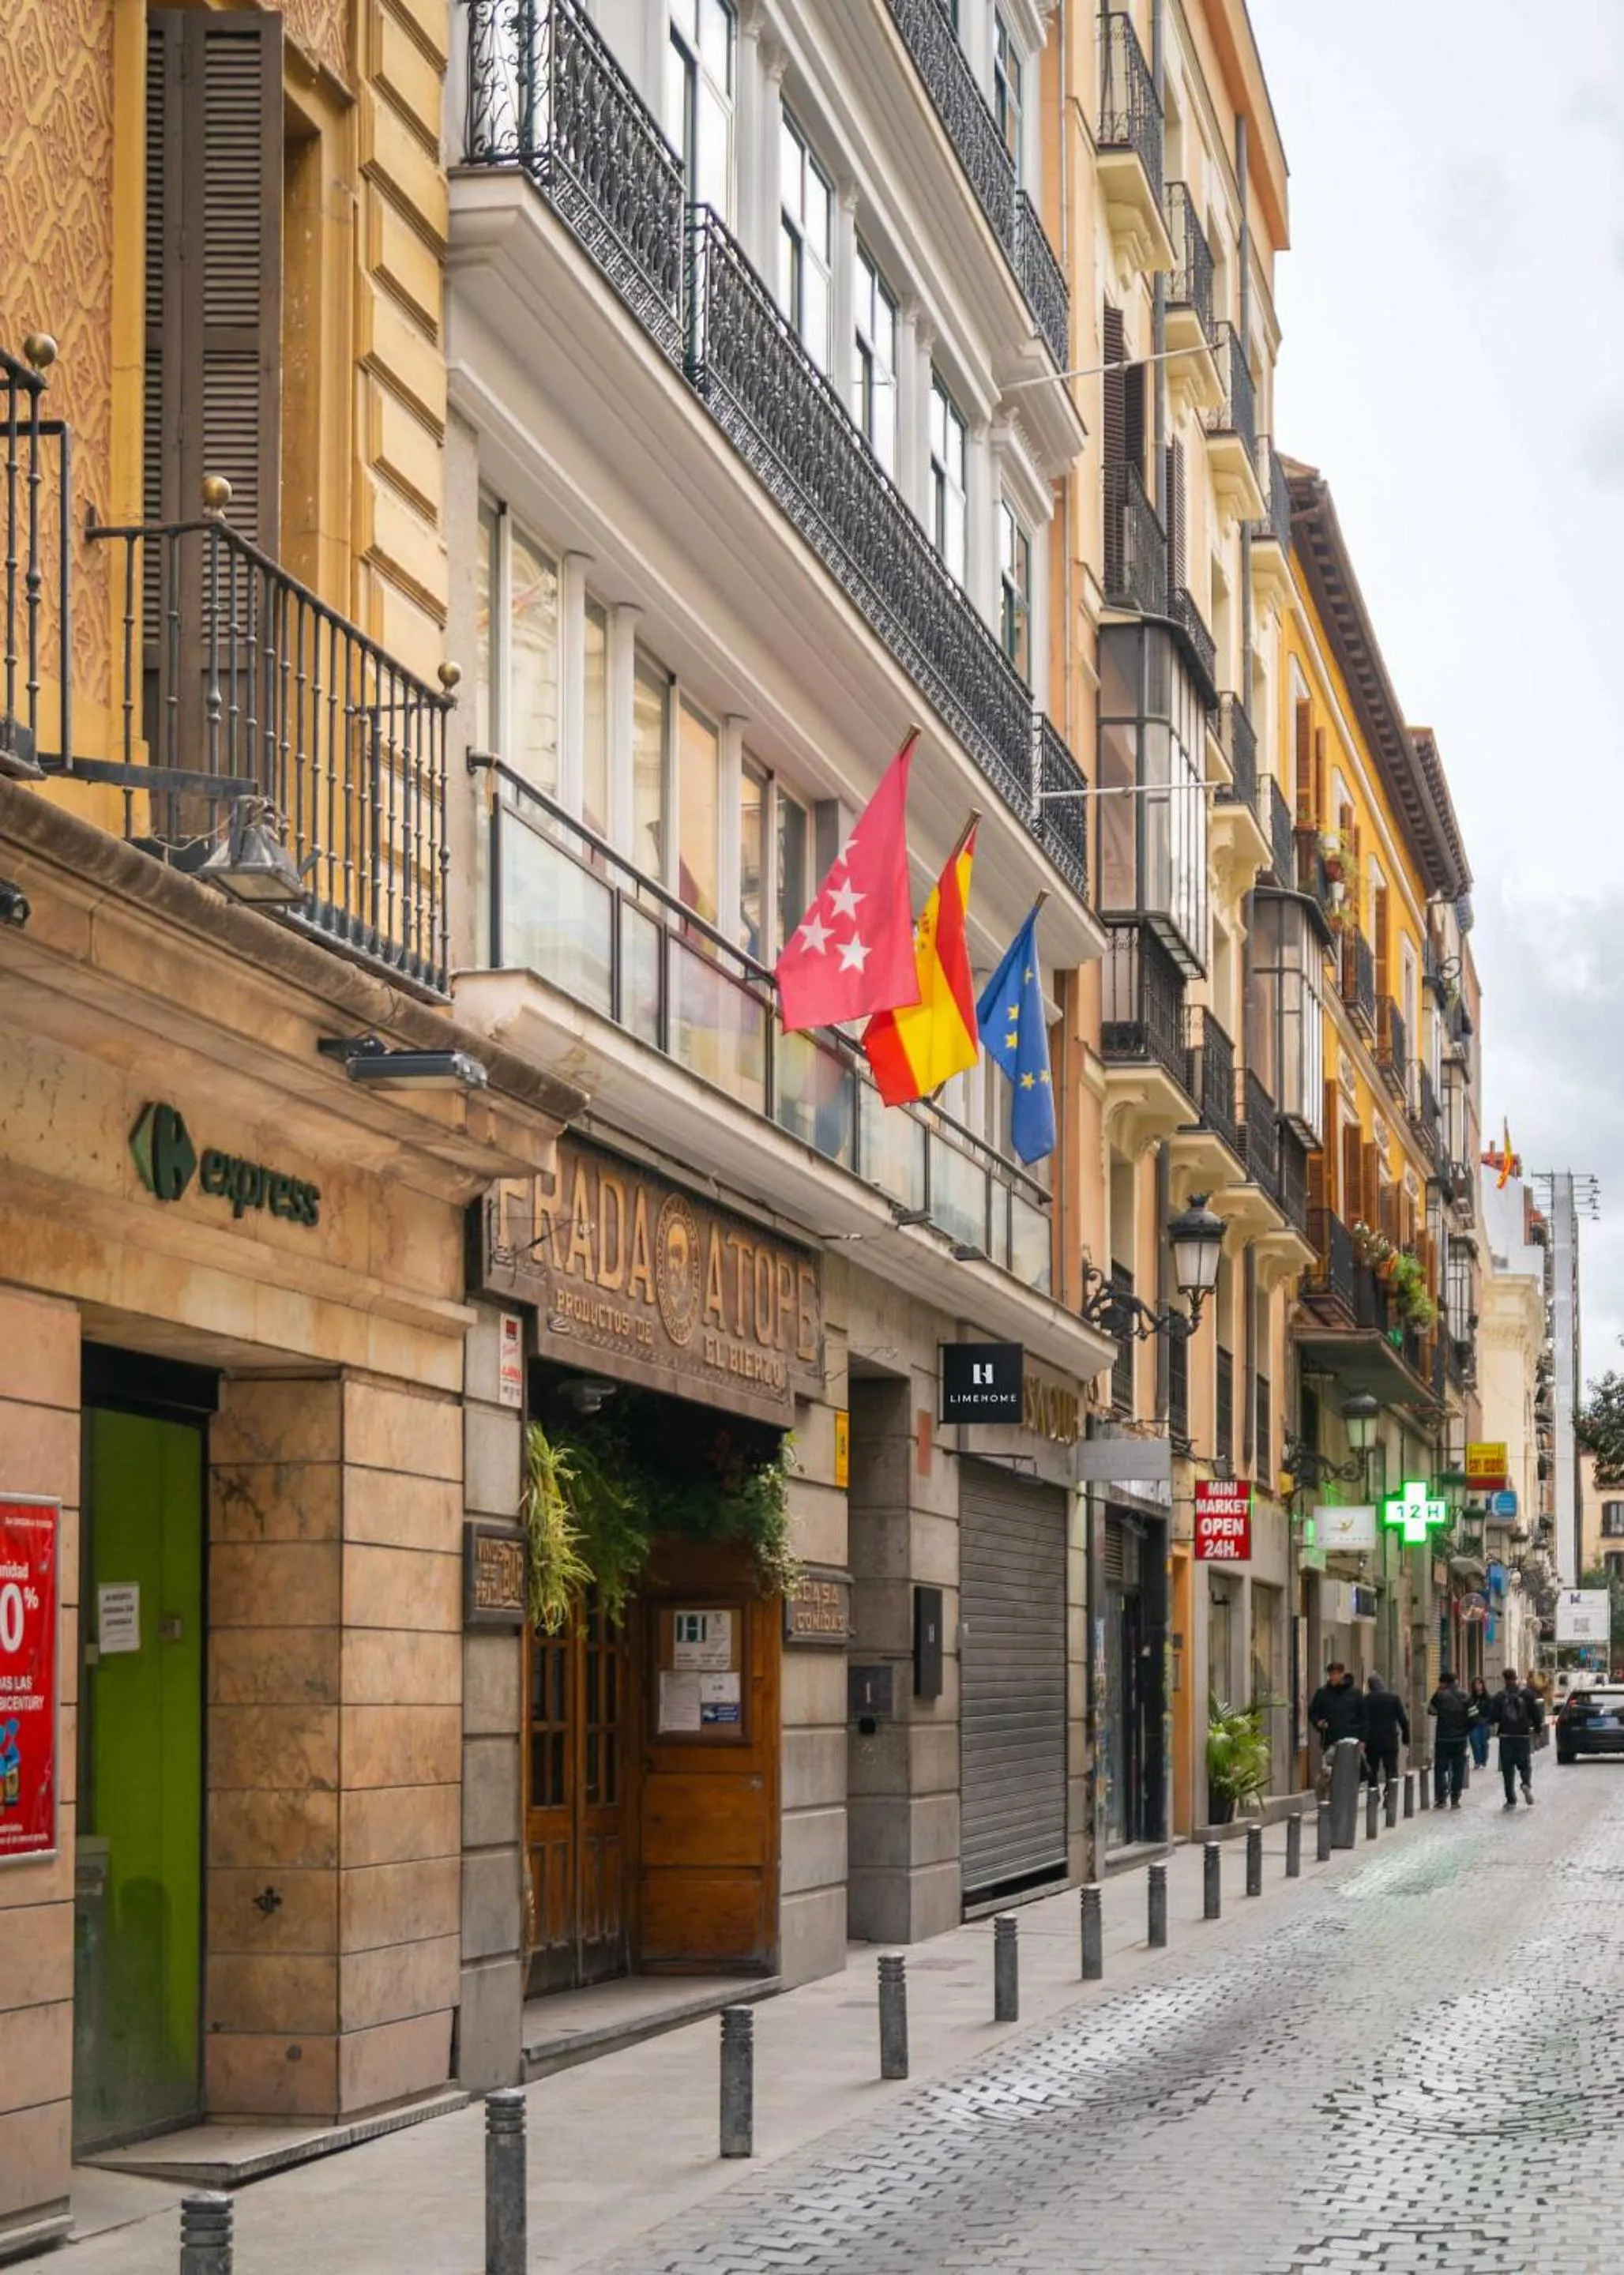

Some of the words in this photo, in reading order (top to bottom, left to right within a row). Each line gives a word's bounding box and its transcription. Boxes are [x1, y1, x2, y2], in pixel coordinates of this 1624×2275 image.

[200, 1148, 321, 1227] express
[556, 1288, 630, 1335] PRODUCTOS
[635, 1316, 653, 1344] DE
[704, 1335, 726, 1369] EL
[949, 1393, 1017, 1403] LIMEHOME
[1208, 1481, 1238, 1496] MINI
[1196, 1498, 1250, 1514] MARKET
[1201, 1517, 1245, 1536] OPEN
[1204, 1539, 1240, 1558] 24H.
[803, 1580, 840, 1604] CASA
[796, 1611, 848, 1631] COMIDAS
